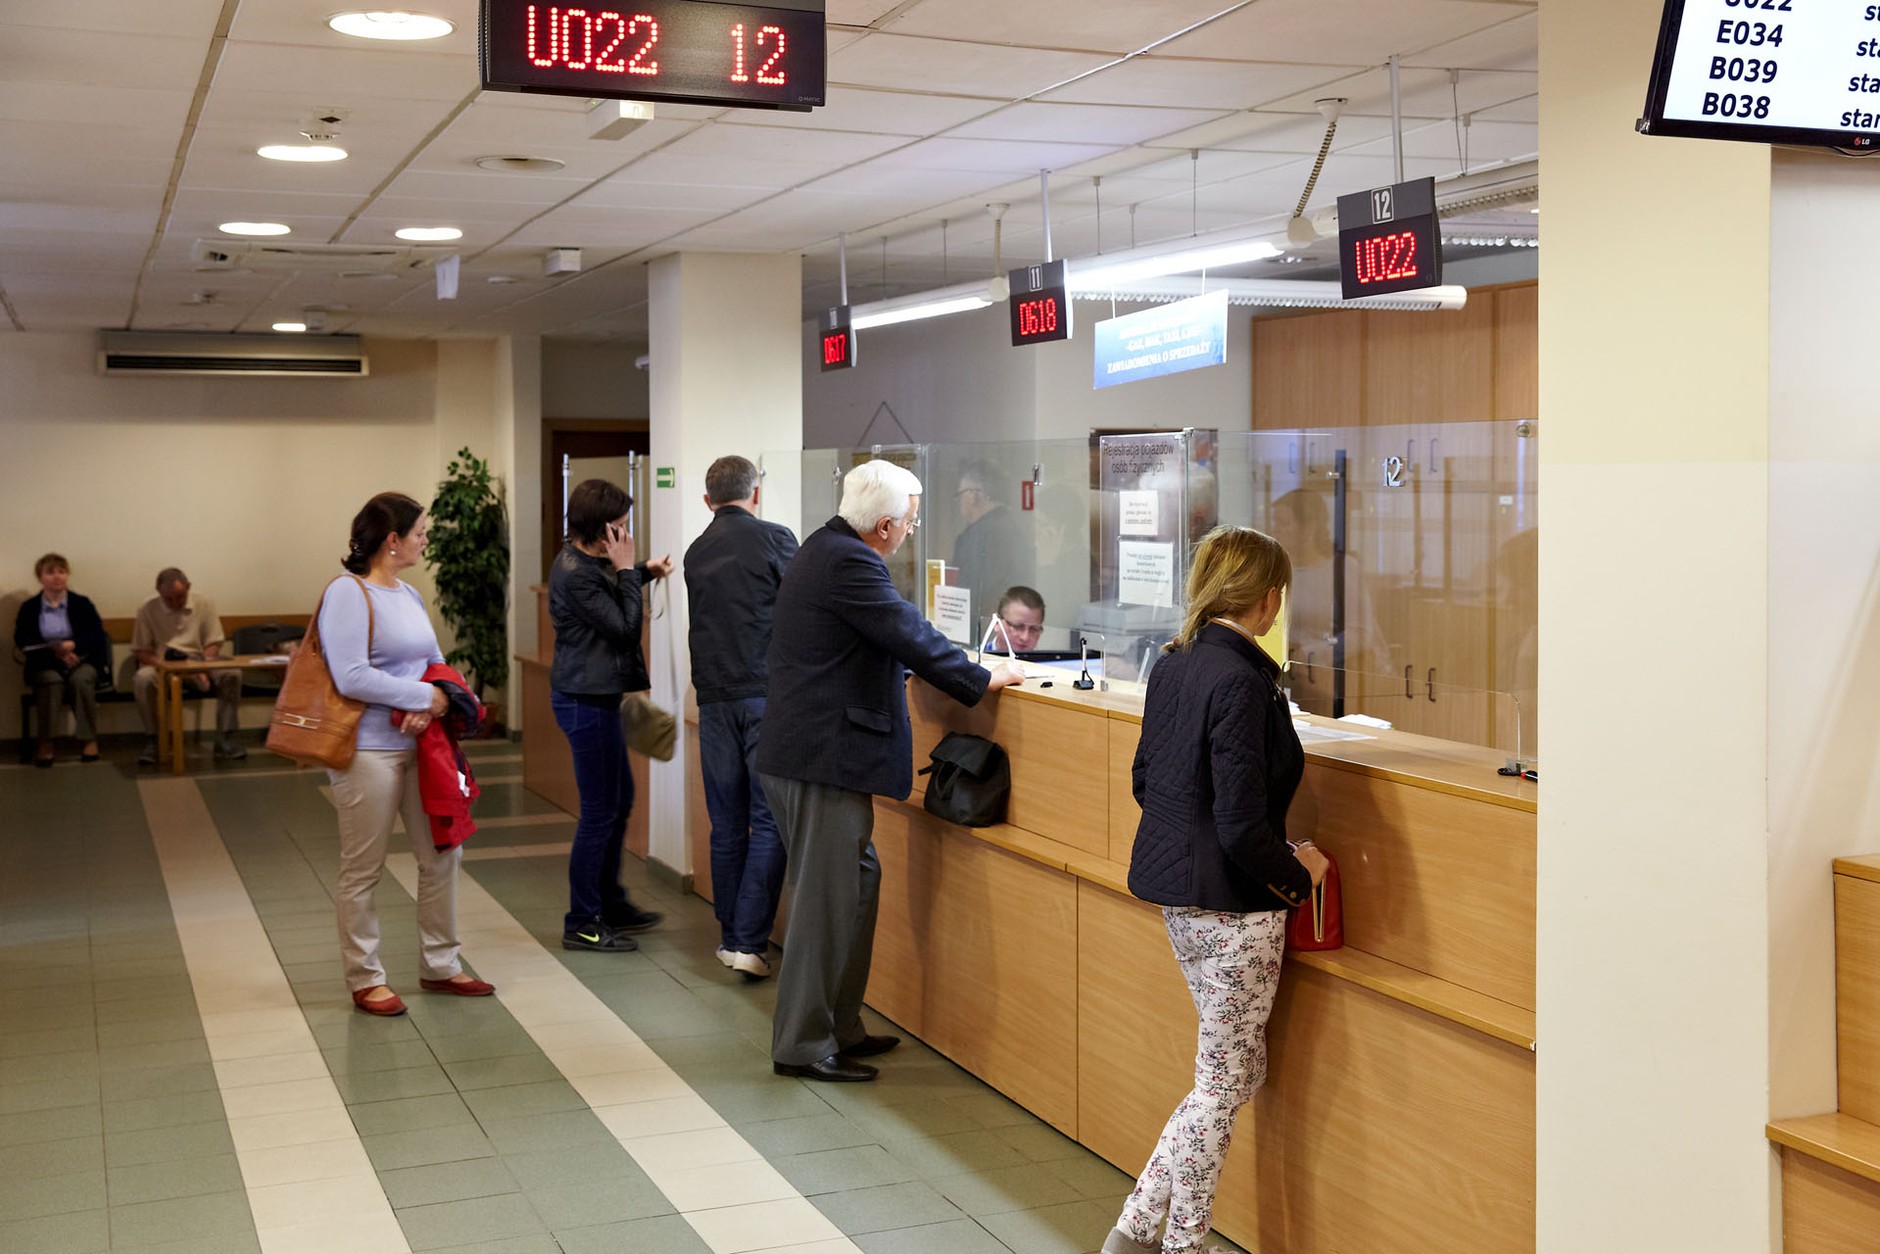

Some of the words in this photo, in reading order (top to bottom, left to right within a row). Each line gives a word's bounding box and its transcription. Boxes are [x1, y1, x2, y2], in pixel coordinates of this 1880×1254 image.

[527, 5, 658, 75] U022
[731, 23, 786, 85] 12
[1716, 19, 1784, 47] E034
[1709, 56, 1778, 84] B039
[1702, 92, 1771, 119] B038
[1374, 190, 1391, 220] 12
[1355, 232, 1416, 283] U022
[1031, 268, 1040, 288] 11
[1103, 442, 1139, 459] Rejestracja
[1140, 440, 1175, 459] pojazdów
[1111, 460, 1128, 473] osób
[1130, 460, 1164, 475] fizycznych
[1382, 456, 1403, 487] 12
